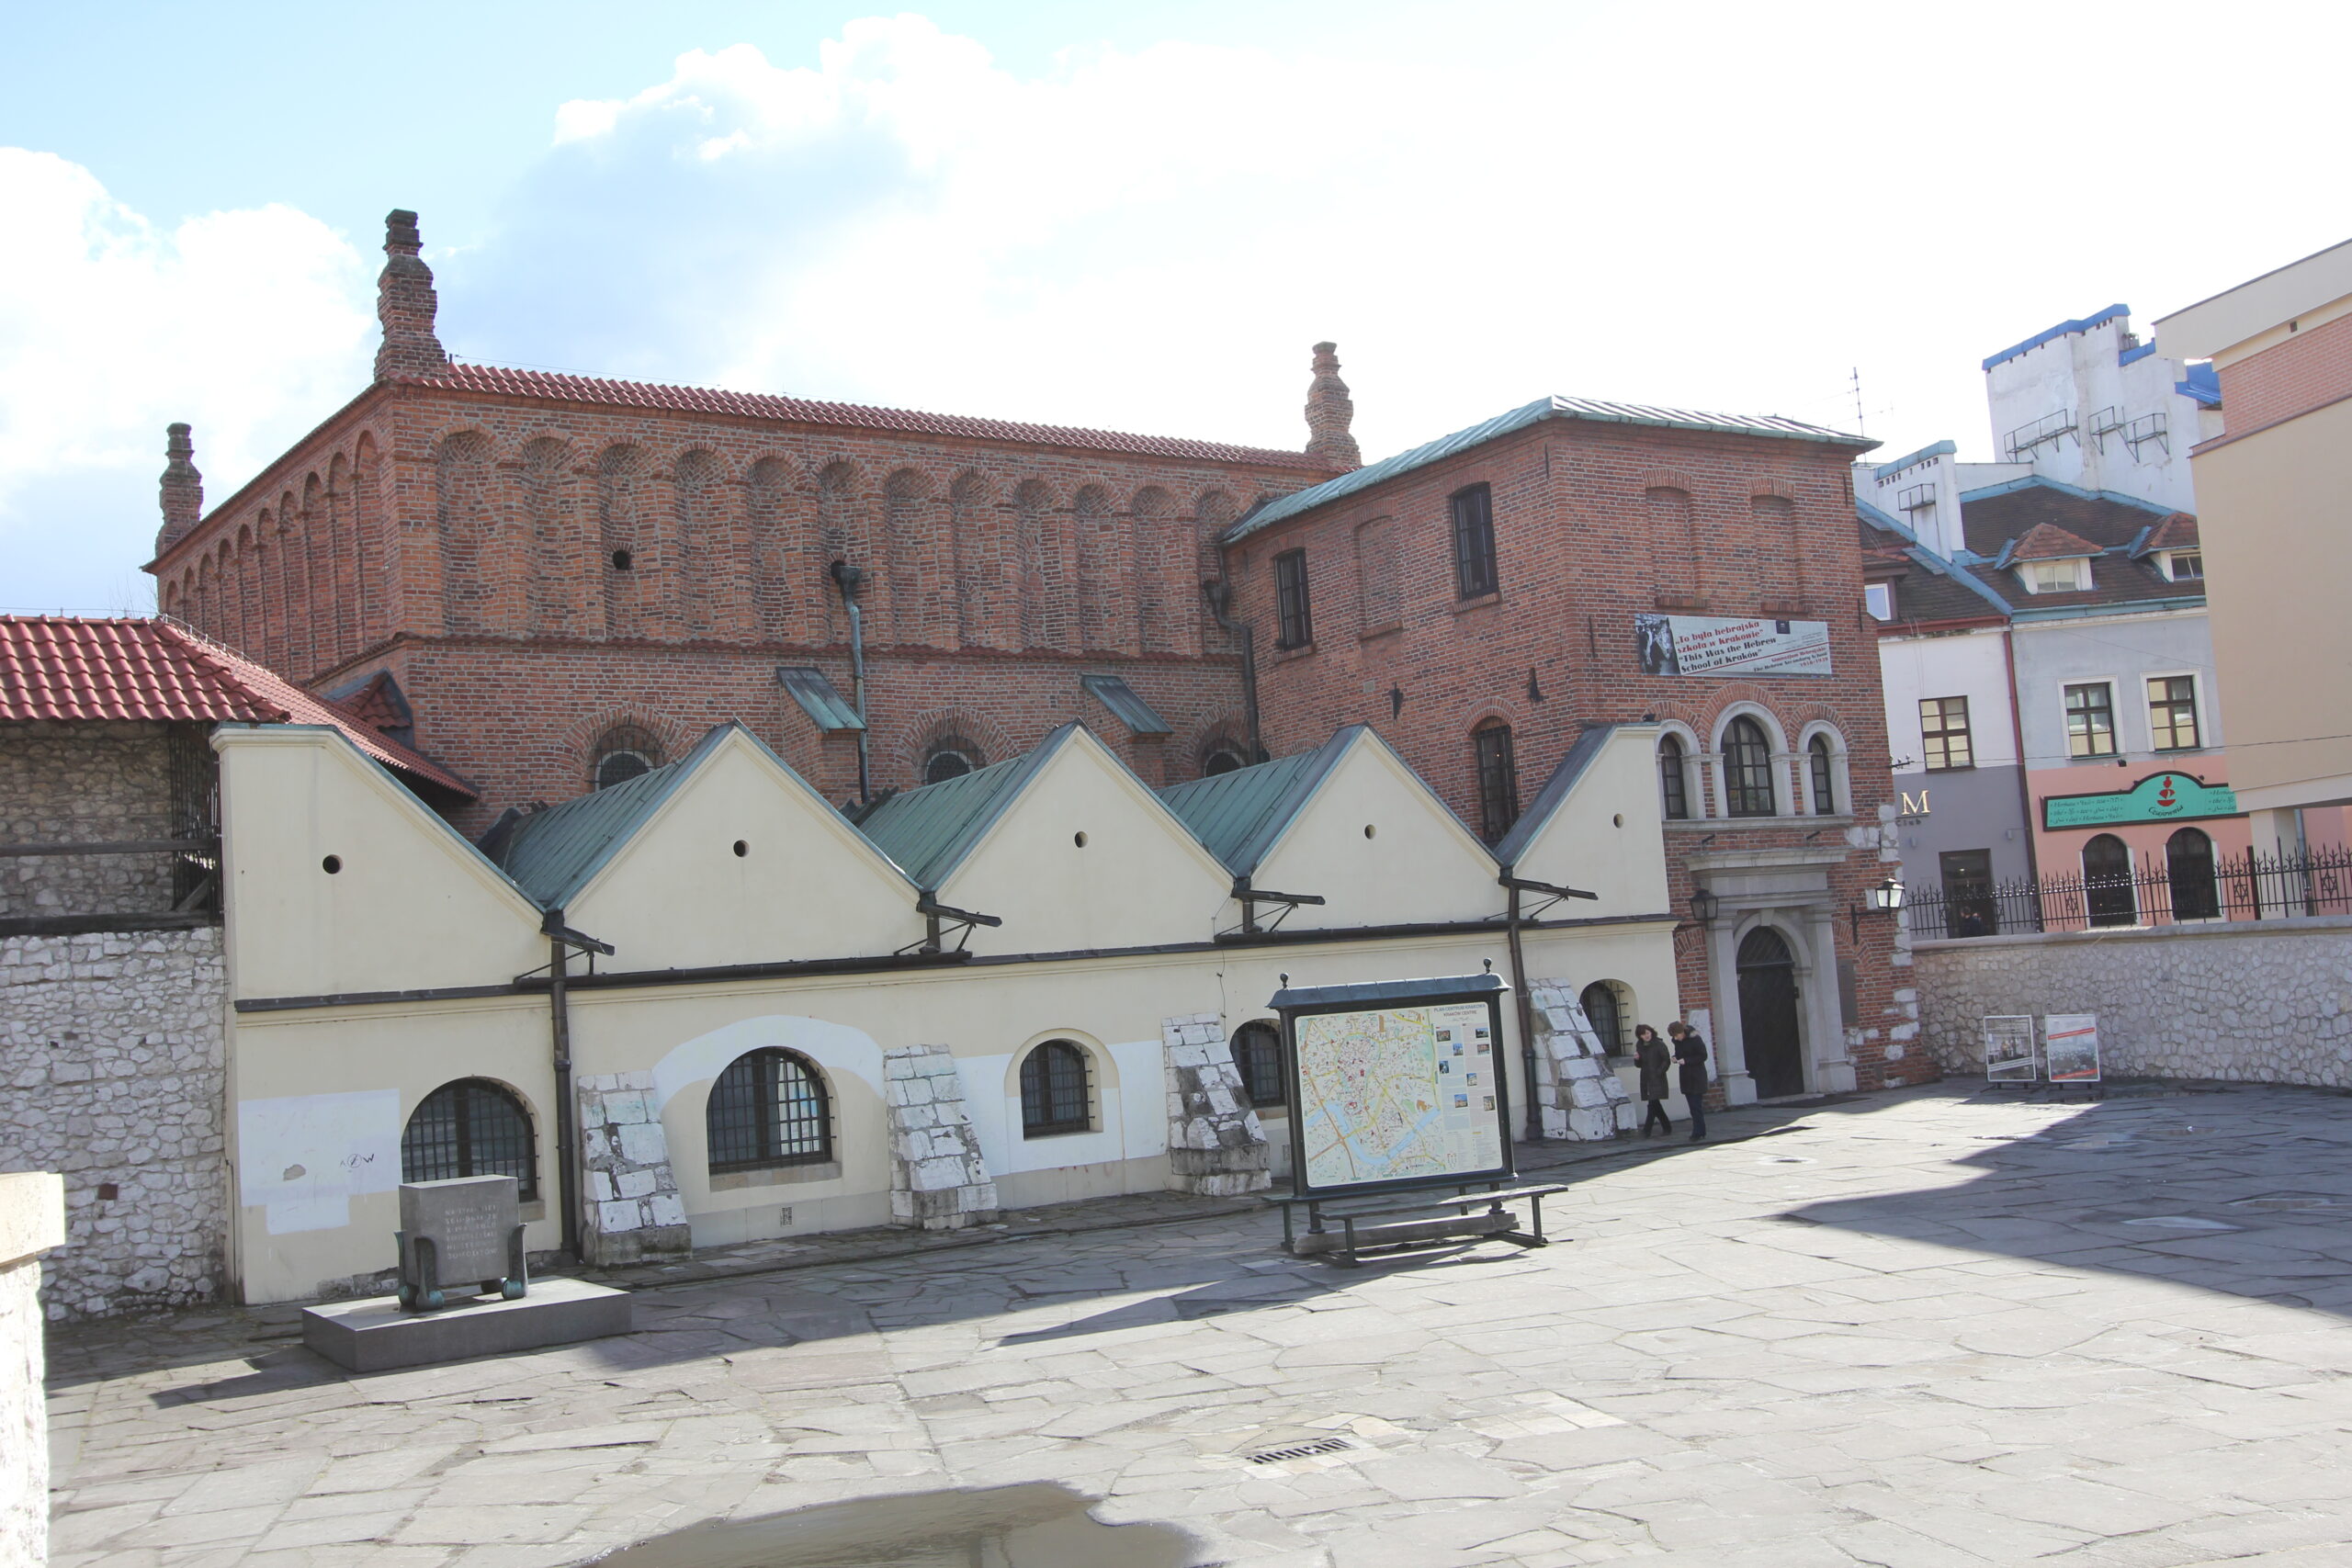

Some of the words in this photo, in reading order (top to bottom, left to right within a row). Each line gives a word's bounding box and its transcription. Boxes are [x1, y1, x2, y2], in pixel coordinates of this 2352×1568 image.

[1691, 631, 1713, 641] była
[1714, 621, 1759, 636] hebrajska
[1678, 643, 1706, 654] szkoła
[1705, 648, 1724, 658] Was
[1727, 644, 1741, 653] the
[1744, 637, 1777, 649] Hebrew
[1681, 661, 1711, 673] School
[1713, 658, 1723, 666] of
[1900, 789, 1931, 816] M
[1895, 818, 1921, 827] Club
